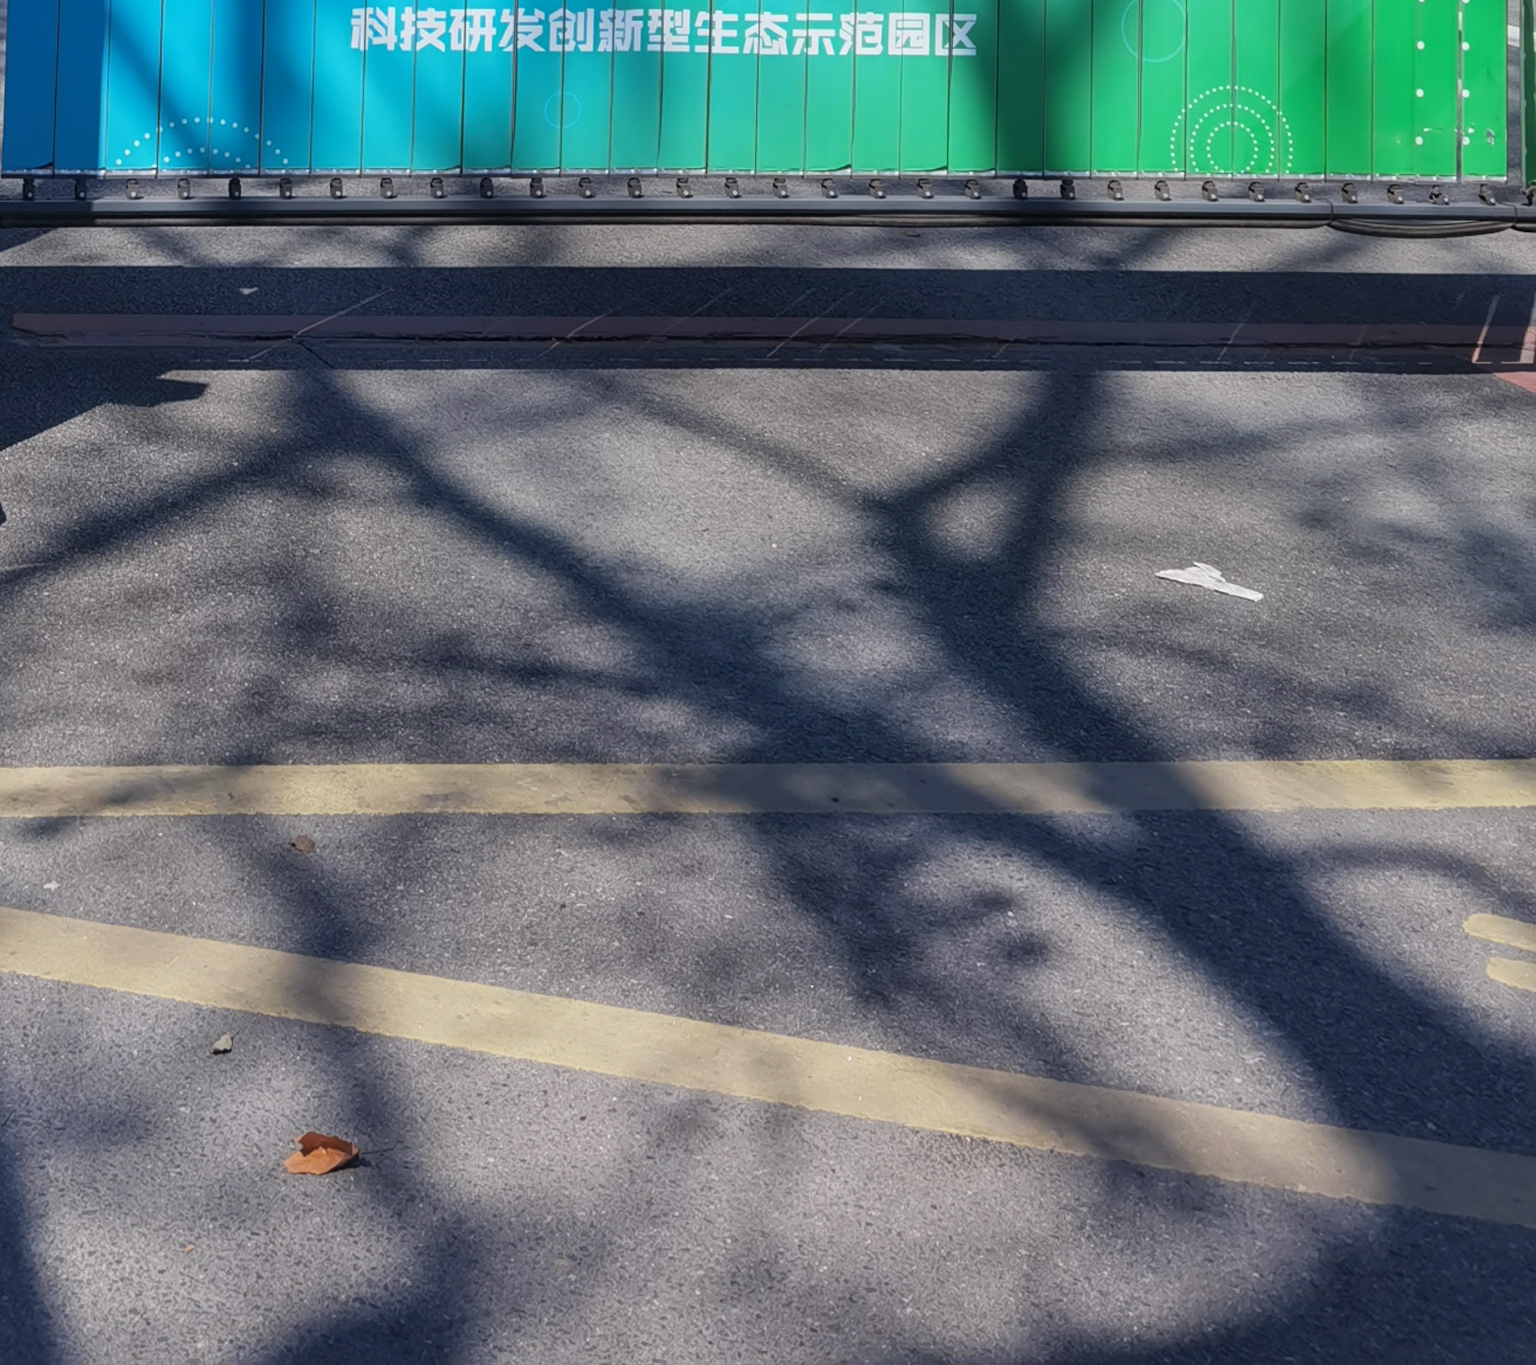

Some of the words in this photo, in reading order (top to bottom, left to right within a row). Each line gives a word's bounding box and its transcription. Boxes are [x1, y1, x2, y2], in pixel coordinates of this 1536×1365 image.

[350, 6, 978, 56] 科技研发创新型生态示范园区
